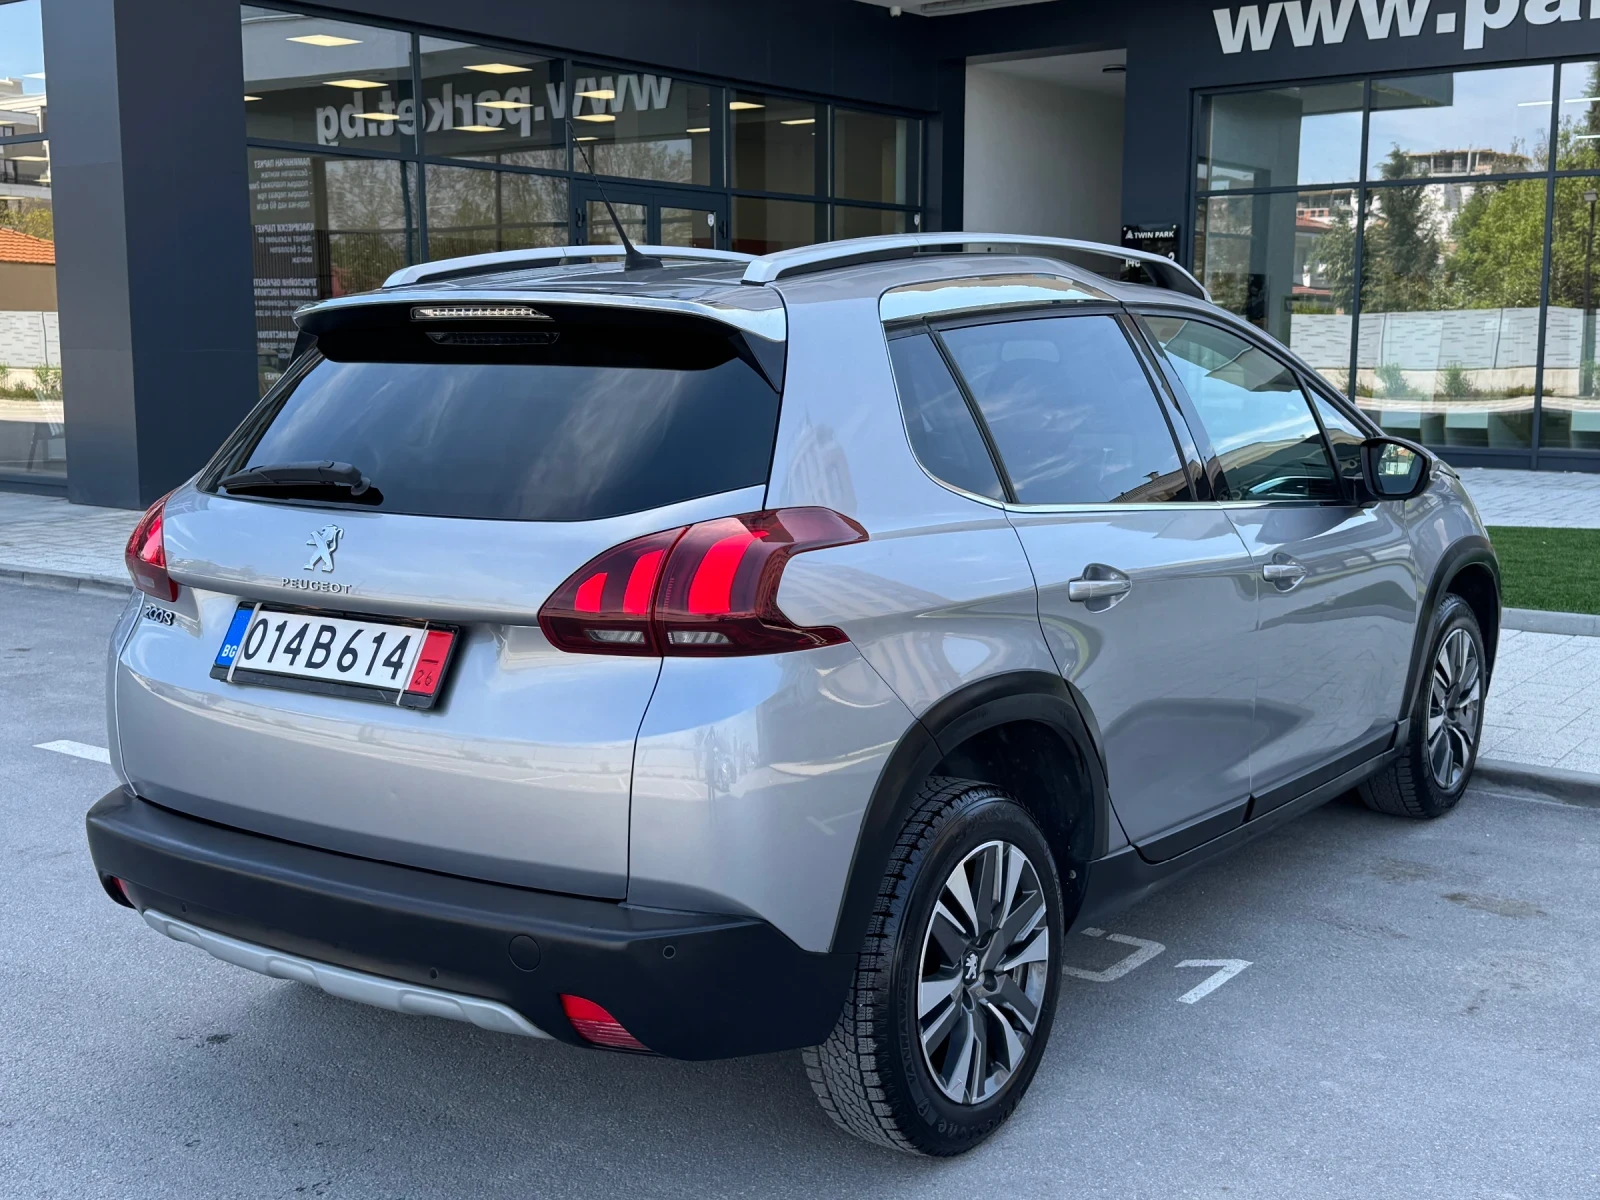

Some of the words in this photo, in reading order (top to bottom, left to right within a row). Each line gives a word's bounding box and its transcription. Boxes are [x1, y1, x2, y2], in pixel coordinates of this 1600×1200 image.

[1212, 0, 1600, 54] www.pa
[1134, 231, 1154, 239] TWIN
[1154, 230, 1175, 239] PARK
[281, 577, 352, 594] PEUGEOT
[144, 603, 174, 626] 2008
[221, 643, 238, 658] BG
[243, 618, 412, 680] 014B614
[414, 669, 433, 687] 26
